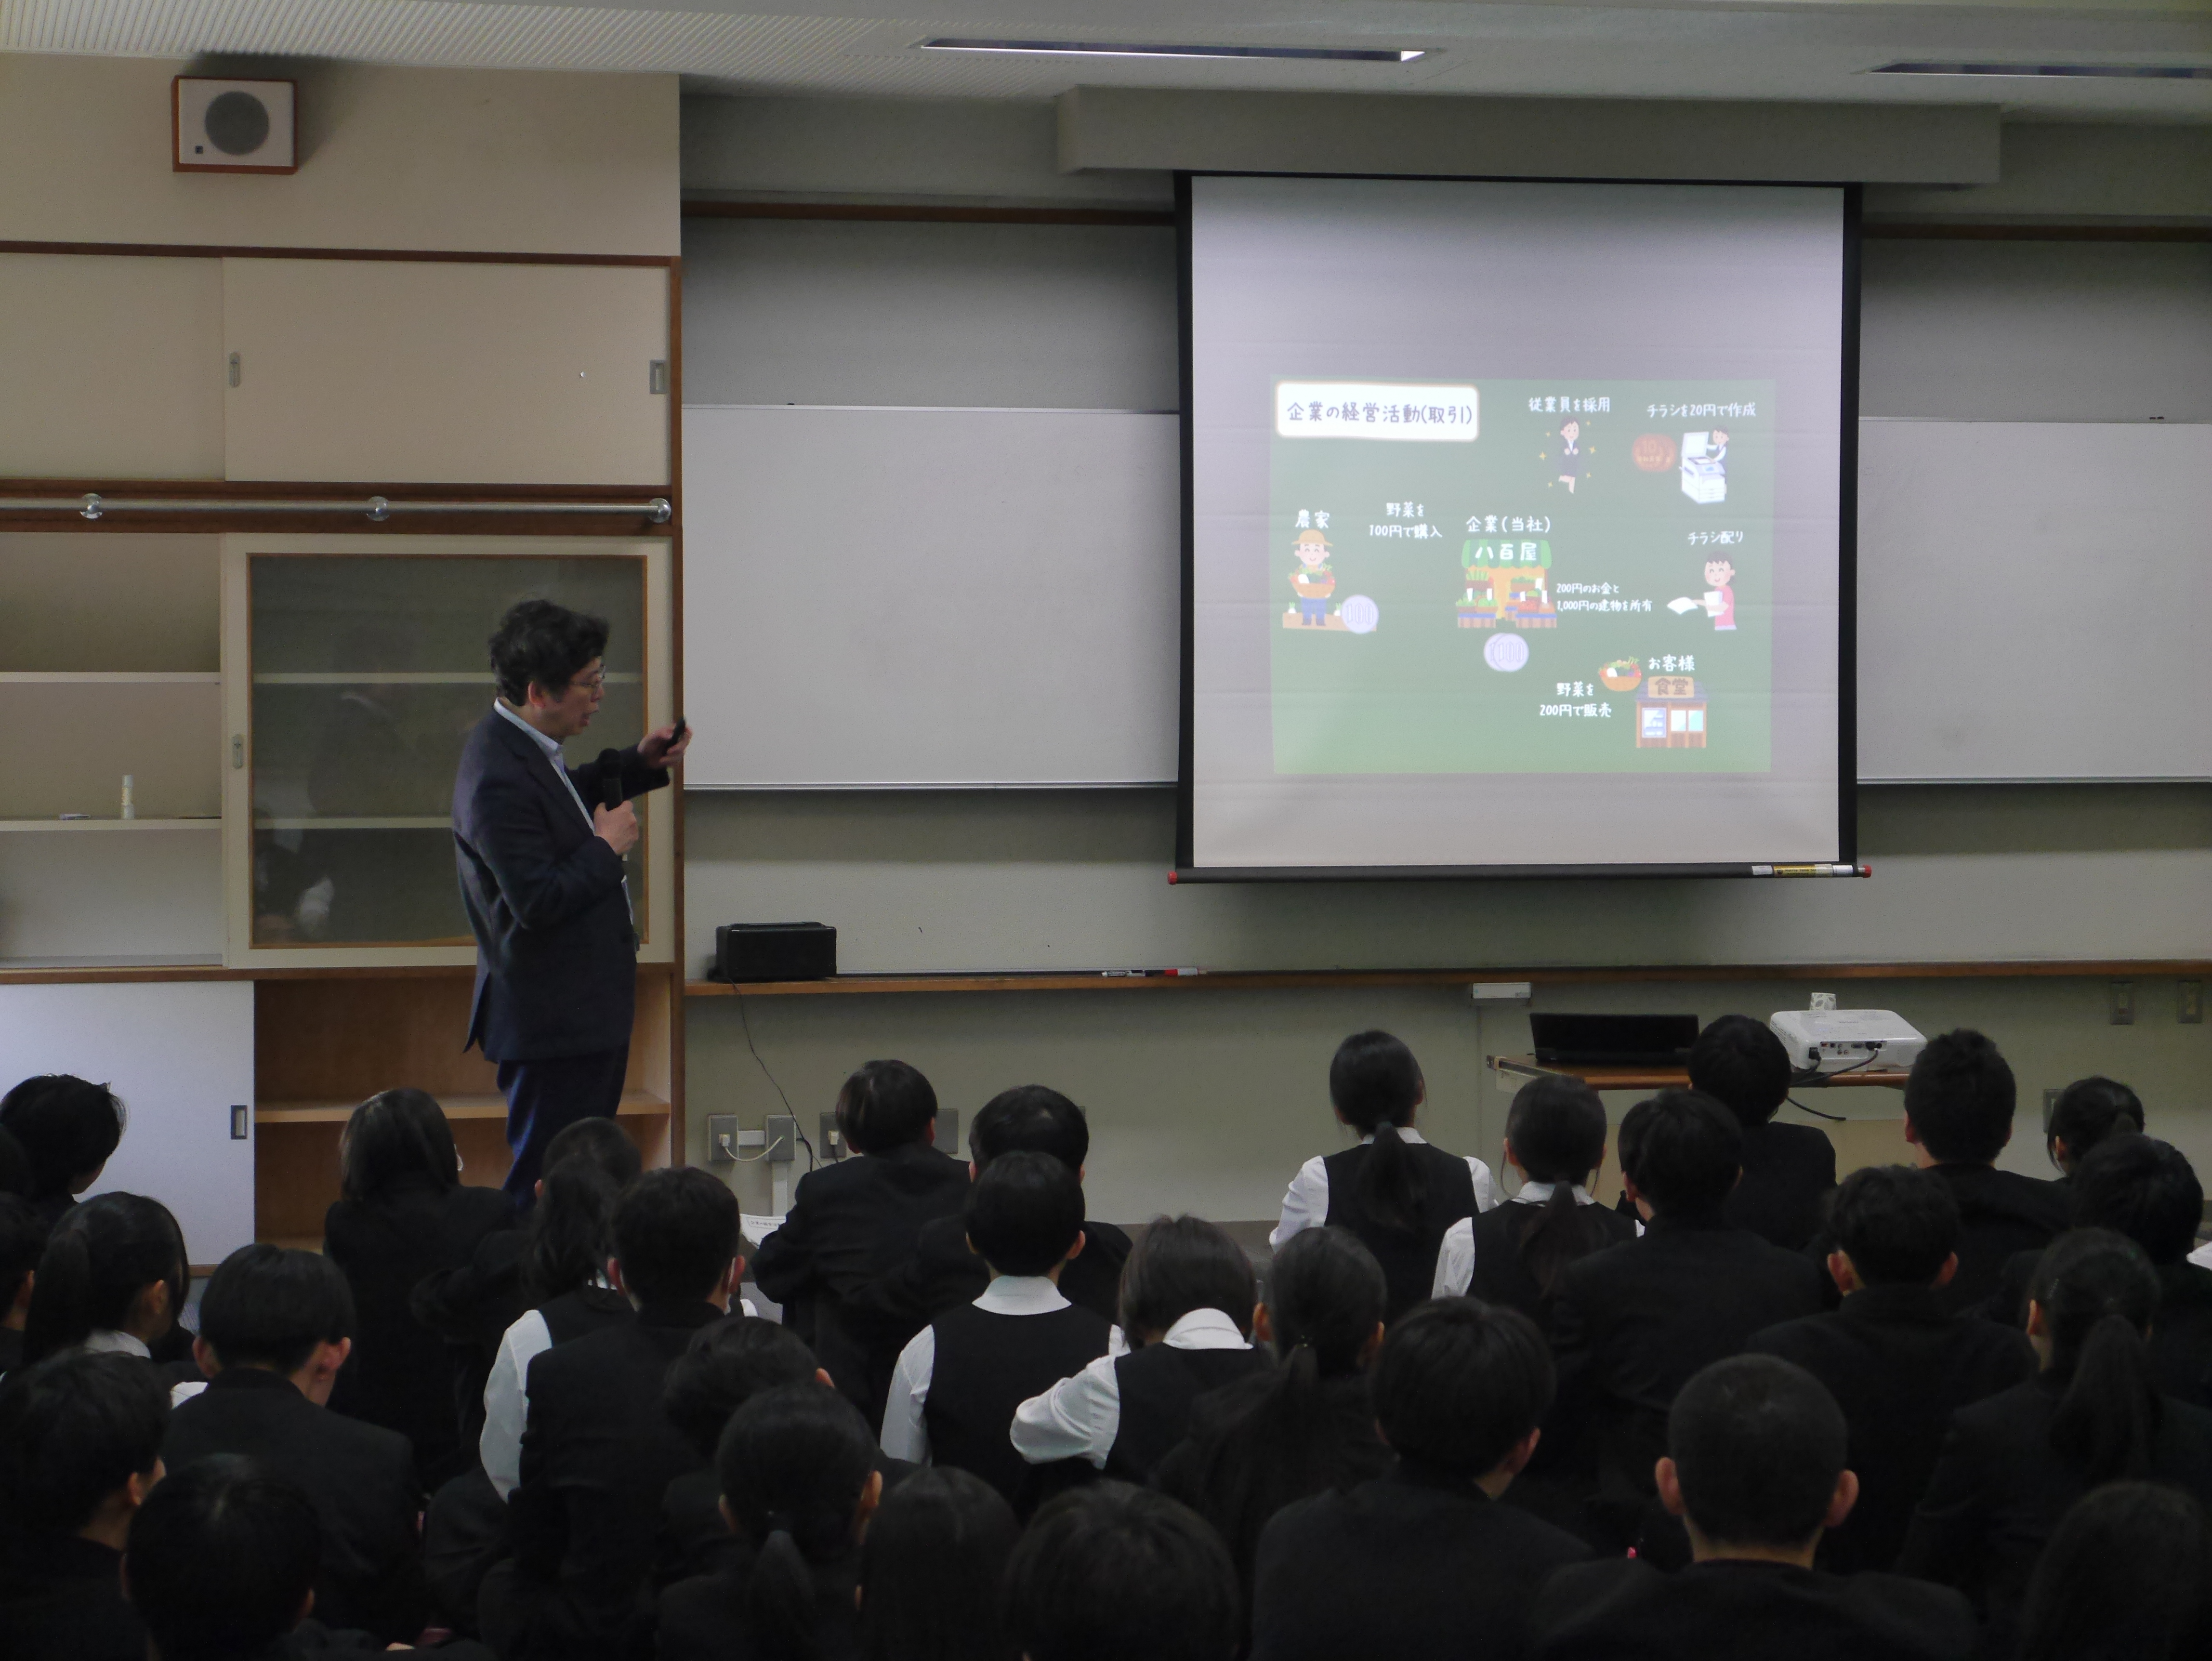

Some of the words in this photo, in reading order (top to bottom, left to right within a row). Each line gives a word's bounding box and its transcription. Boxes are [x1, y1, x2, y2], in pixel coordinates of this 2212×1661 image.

[1287, 401, 1473, 425] 企業の経営活動(取引)
[1528, 396, 1610, 413] 従業員を採用
[1647, 402, 1756, 418] チラシを20円で作成
[1295, 508, 1330, 529] 農家
[1386, 501, 1425, 518] 野菜を
[1369, 524, 1443, 540] 100円で購入
[1466, 514, 1551, 534] 企業(当社)
[1687, 530, 1744, 546] チラシ配り
[1475, 541, 1537, 562] 八百屋
[1556, 581, 1620, 595] 200円のお金と
[1345, 603, 1373, 625] 100
[1556, 598, 1653, 613] 1,000円の建物を所有
[1497, 641, 1524, 663] 100
[1648, 654, 1696, 672] お客様
[1556, 681, 1595, 699] 野菜を
[1655, 677, 1689, 697] 食堂
[1539, 703, 1613, 719] 200円で販売
